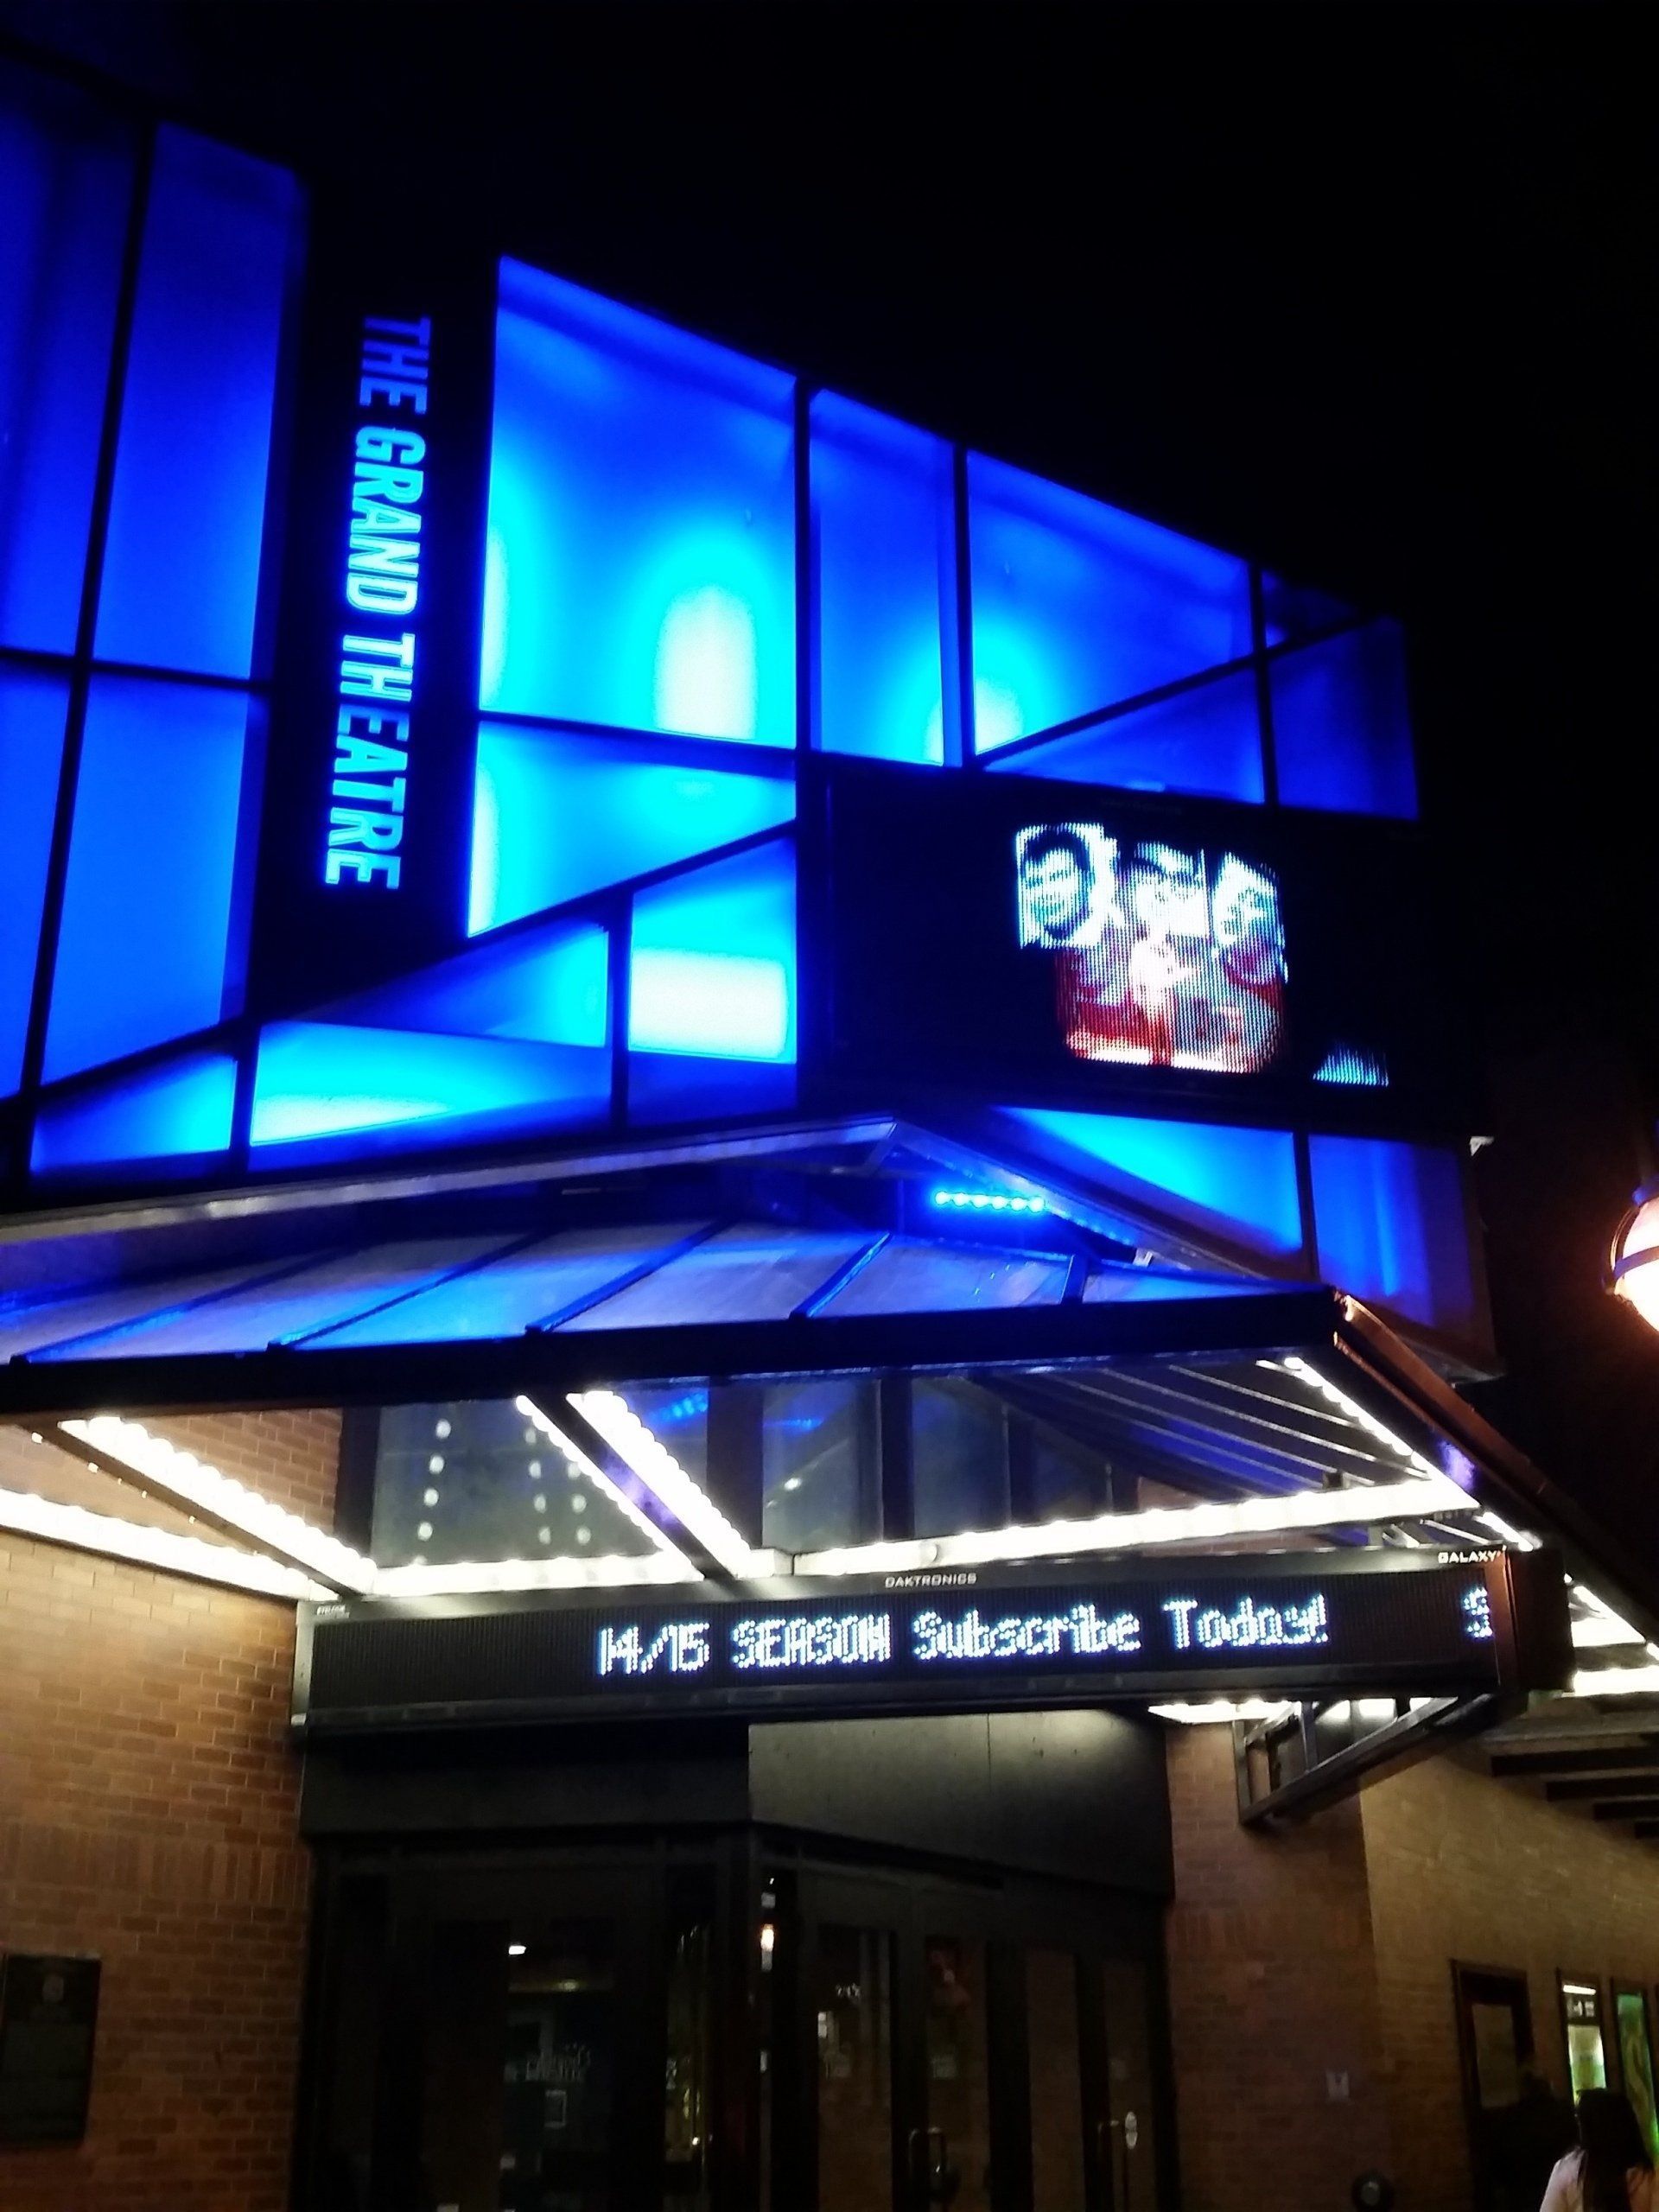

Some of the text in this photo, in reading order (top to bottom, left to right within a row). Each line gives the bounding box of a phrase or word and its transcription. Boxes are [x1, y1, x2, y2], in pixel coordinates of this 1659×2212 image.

[325, 317, 430, 889] THE GRAND THEATRE
[885, 1573, 977, 1588] DAKTRONICS
[600, 1593, 1329, 1675] 14/15 SEASON Subscribe Today!
